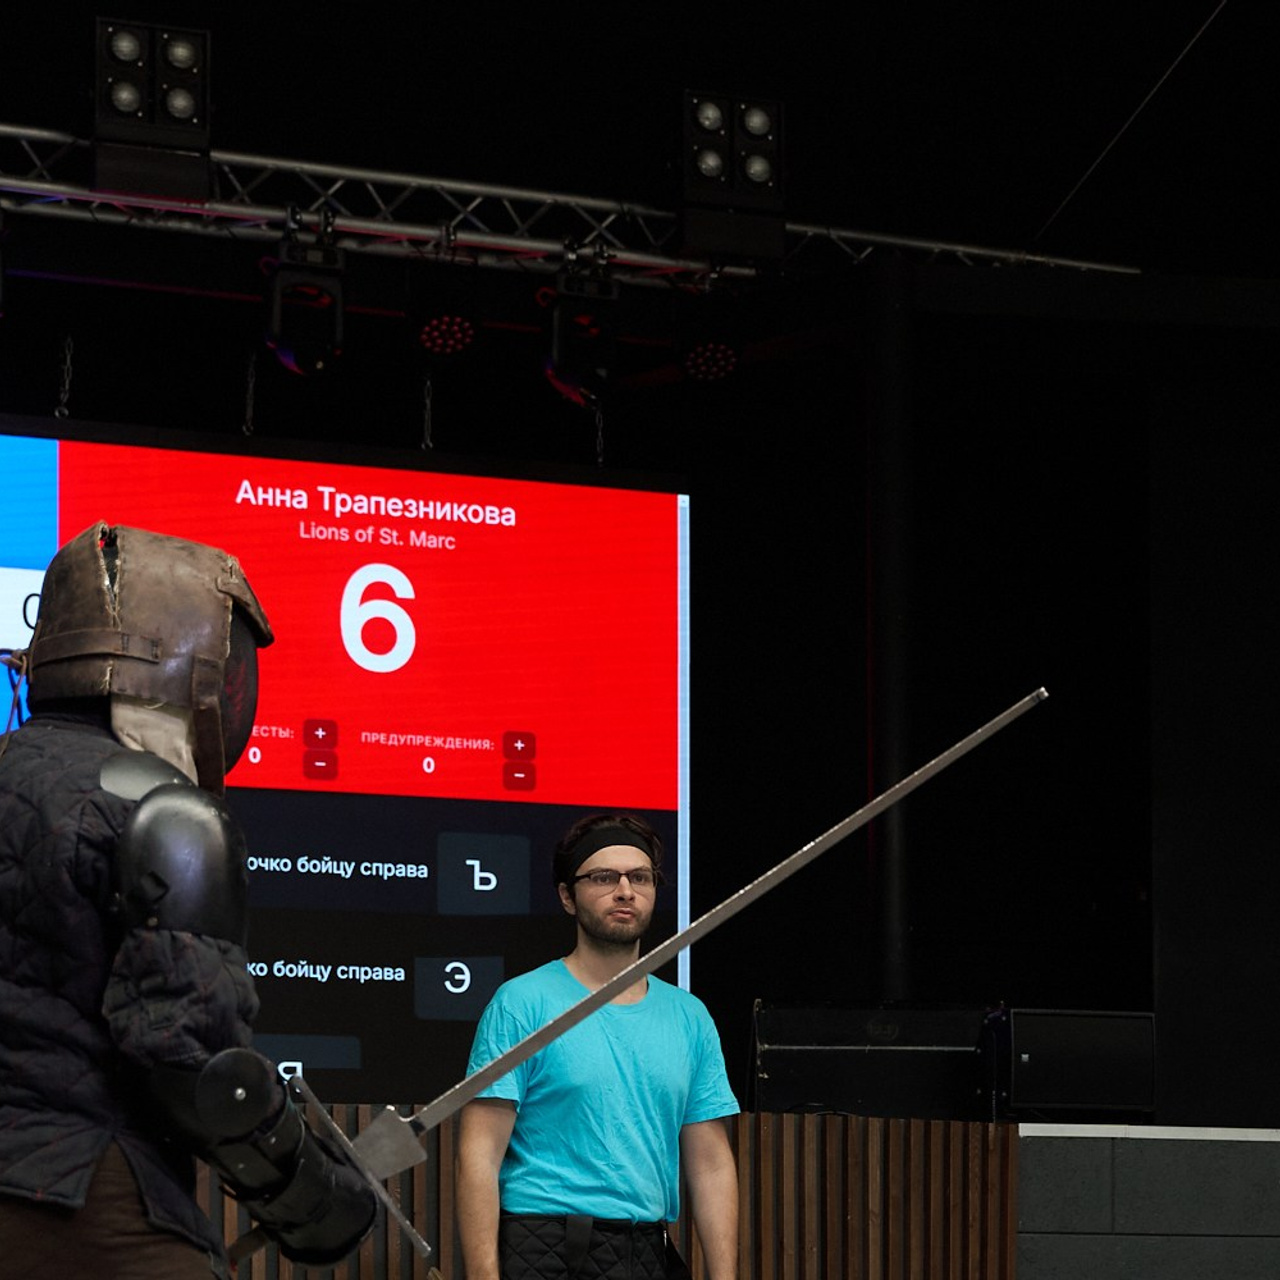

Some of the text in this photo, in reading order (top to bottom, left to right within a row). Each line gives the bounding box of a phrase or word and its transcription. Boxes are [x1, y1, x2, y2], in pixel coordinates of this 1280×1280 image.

[235, 480, 517, 527] Анна Трапезникова
[299, 521, 456, 550] Lions of St. Marc
[340, 563, 416, 673] 6
[251, 725, 295, 739] ЕСТЫ:
[360, 731, 495, 750] ПРЕДУПРЕЖДЕНИЯ:
[248, 746, 262, 763] 0
[422, 756, 435, 774] 0
[297, 855, 356, 879] бойцу
[360, 862, 429, 881] справа
[465, 859, 498, 891] Ъ
[247, 959, 406, 984] ко бойцу справа
[443, 961, 471, 994] Э
